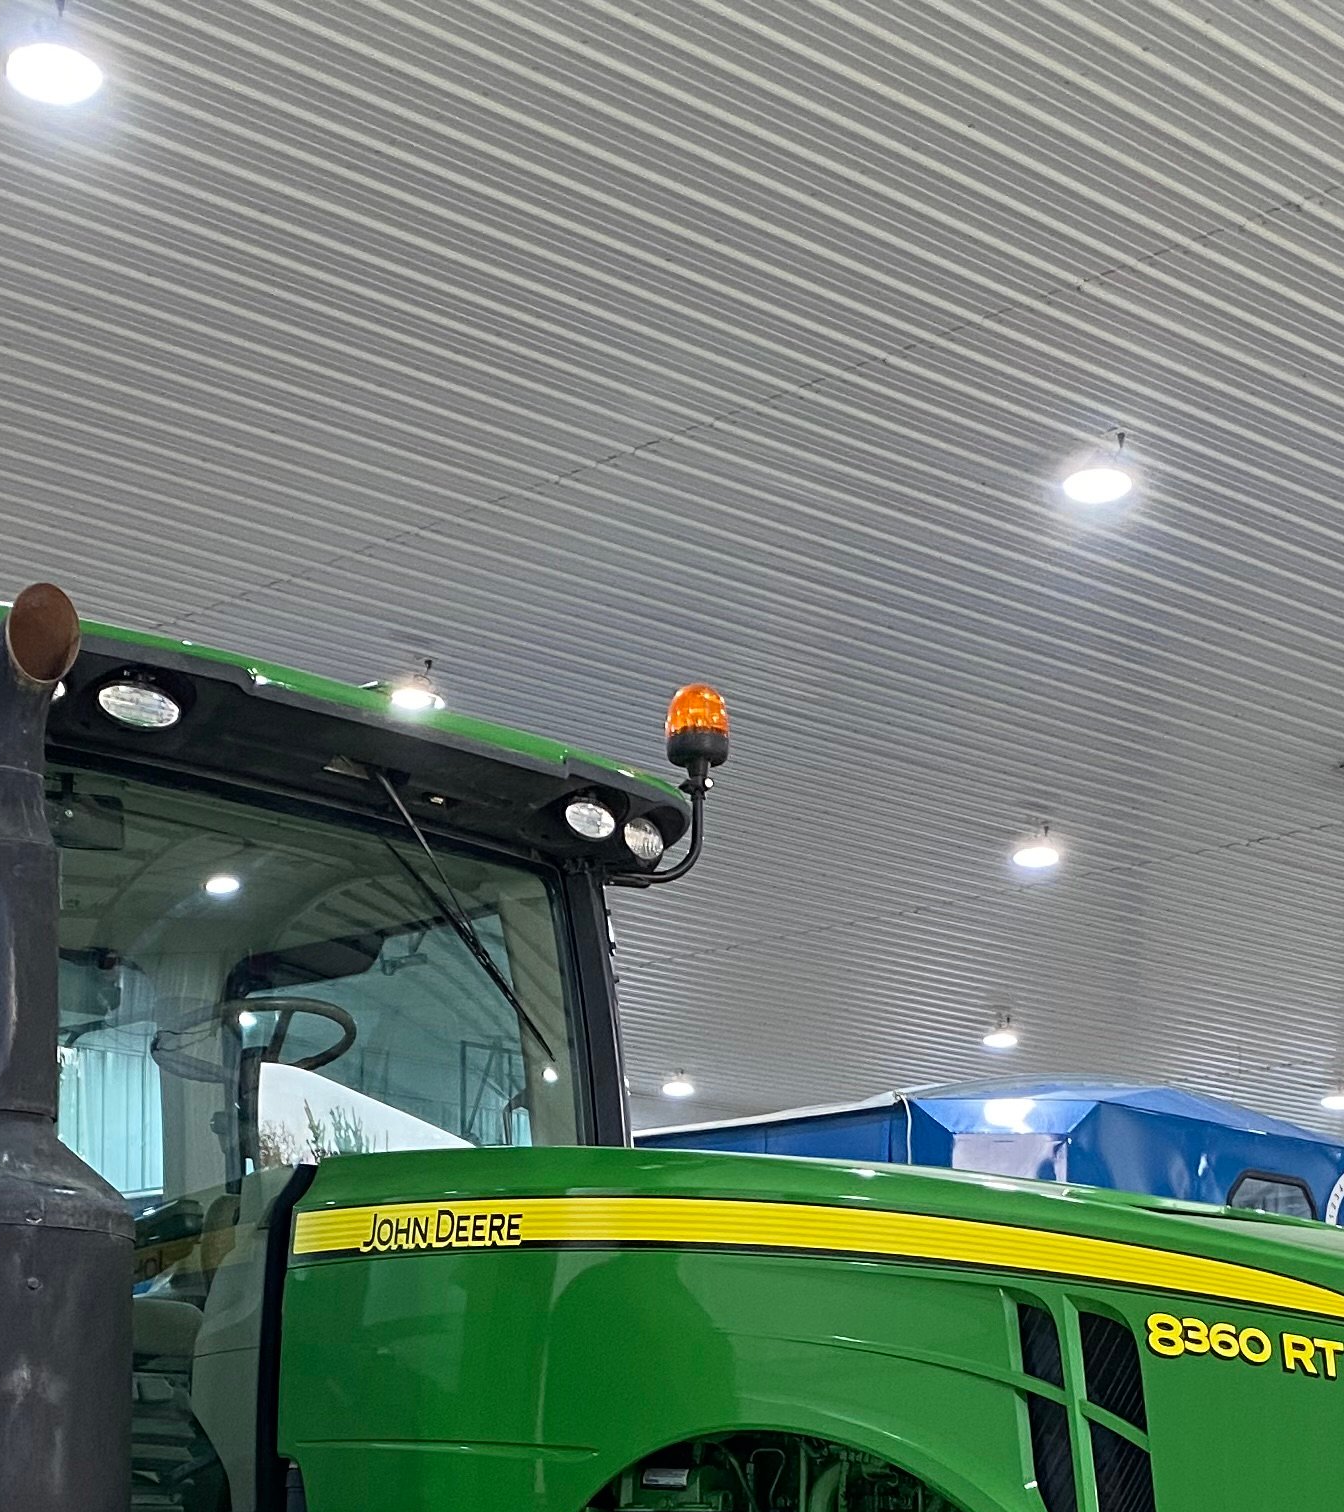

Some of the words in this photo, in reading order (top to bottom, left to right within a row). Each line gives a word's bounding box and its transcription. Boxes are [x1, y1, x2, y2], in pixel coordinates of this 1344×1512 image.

[362, 1212, 429, 1248] JOHN
[435, 1209, 524, 1244] DEERE
[1145, 1312, 1272, 1365] 8360
[1281, 1331, 1344, 1381] RT
